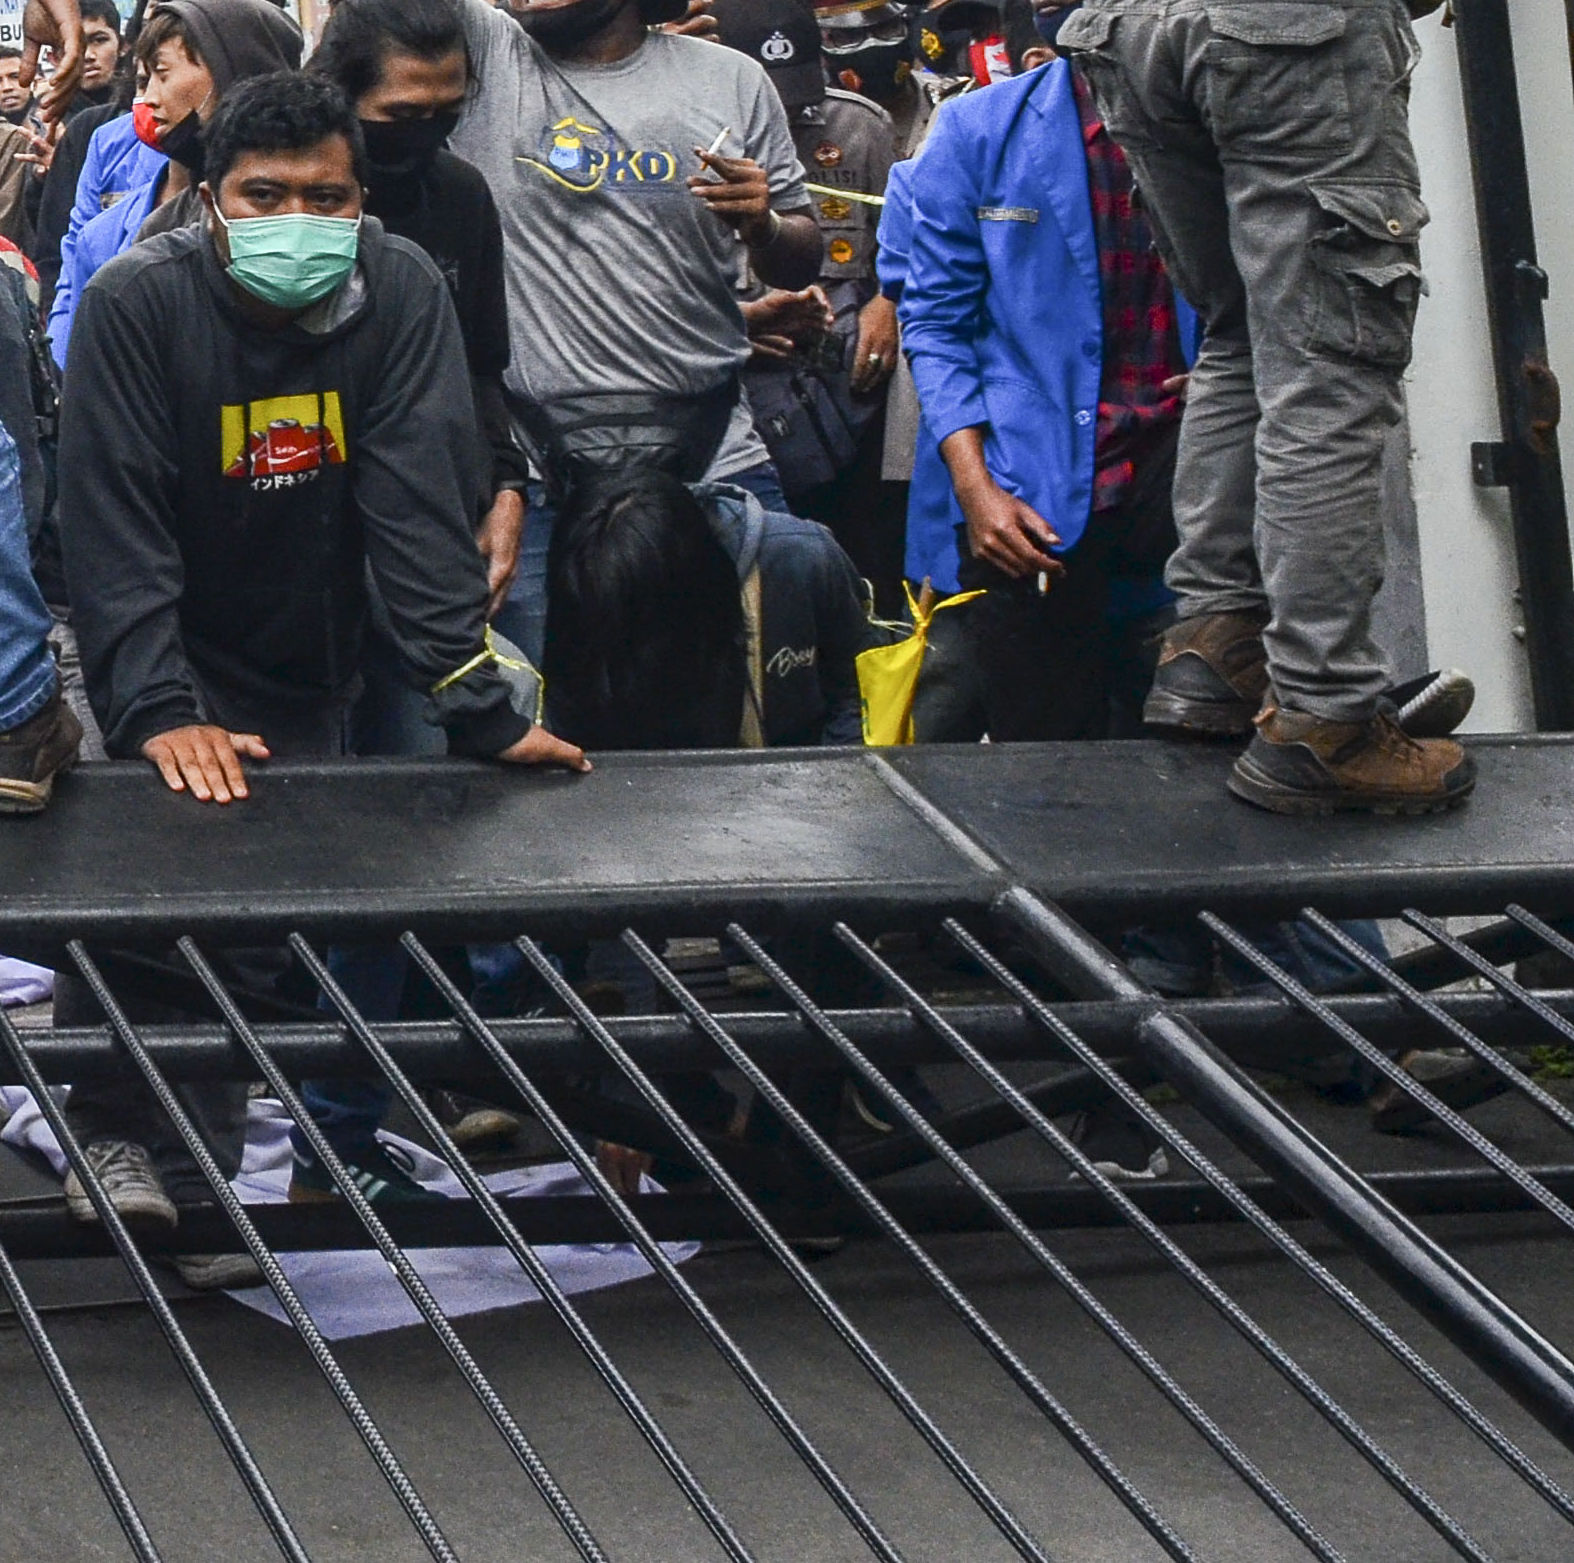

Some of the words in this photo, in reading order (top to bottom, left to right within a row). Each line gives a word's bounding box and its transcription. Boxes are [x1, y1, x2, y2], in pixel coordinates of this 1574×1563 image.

[582, 145, 675, 183] PKD
[807, 169, 857, 186] OLISI
[251, 467, 319, 490] インドネシア
